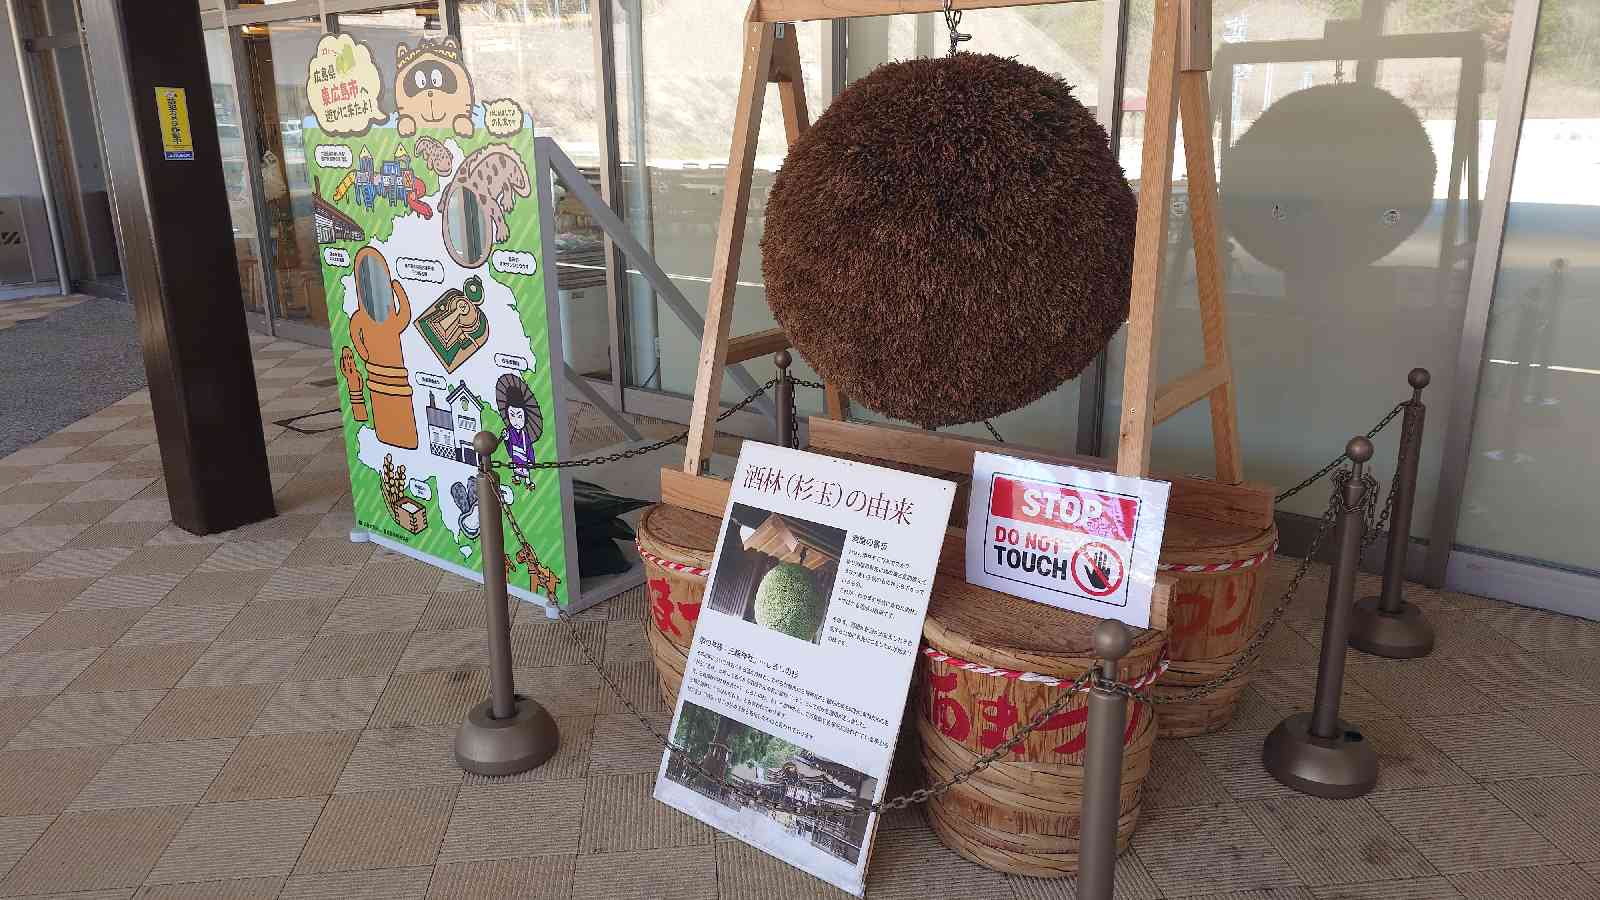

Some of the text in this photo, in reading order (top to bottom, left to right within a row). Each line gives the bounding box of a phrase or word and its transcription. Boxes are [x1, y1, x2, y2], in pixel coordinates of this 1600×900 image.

[743, 464, 915, 526] 酒林(杉玉)の由来
[1022, 488, 1104, 527] STOP
[994, 526, 1064, 554] DO NOT
[993, 545, 1068, 580] TOUCH
